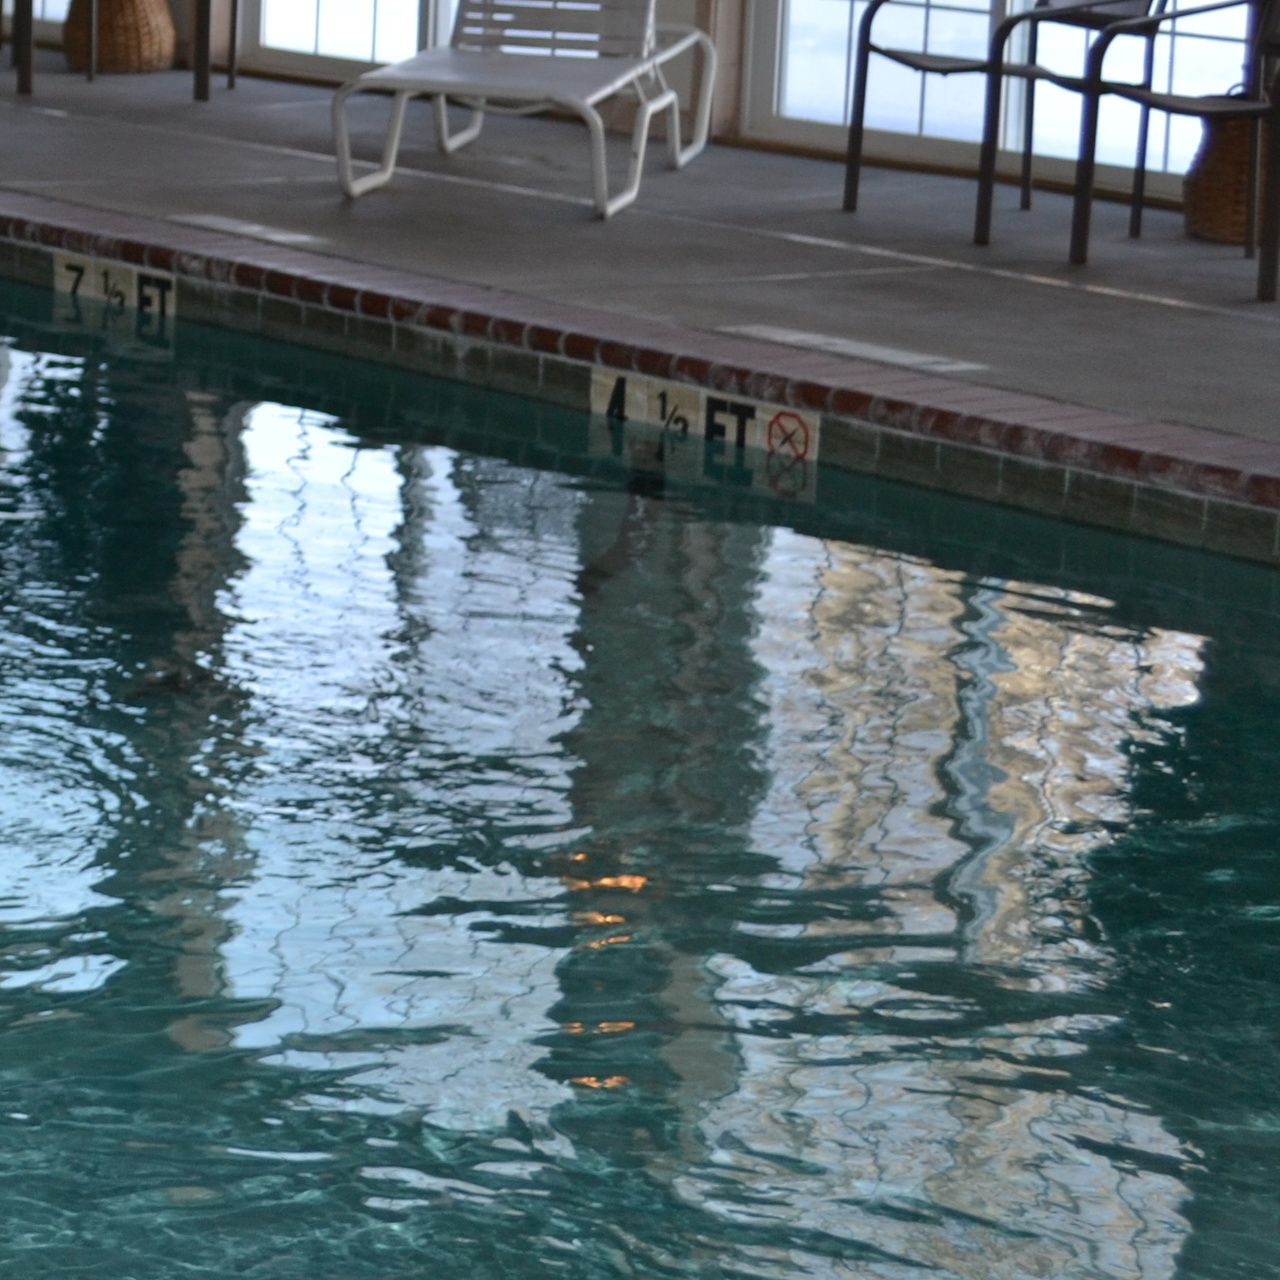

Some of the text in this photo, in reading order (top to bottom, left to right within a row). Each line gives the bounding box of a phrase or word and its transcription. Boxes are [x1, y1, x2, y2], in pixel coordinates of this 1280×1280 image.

[65, 264, 85, 295] 7
[138, 273, 173, 317] FT
[606, 376, 628, 422] 4
[704, 395, 756, 448] FT
